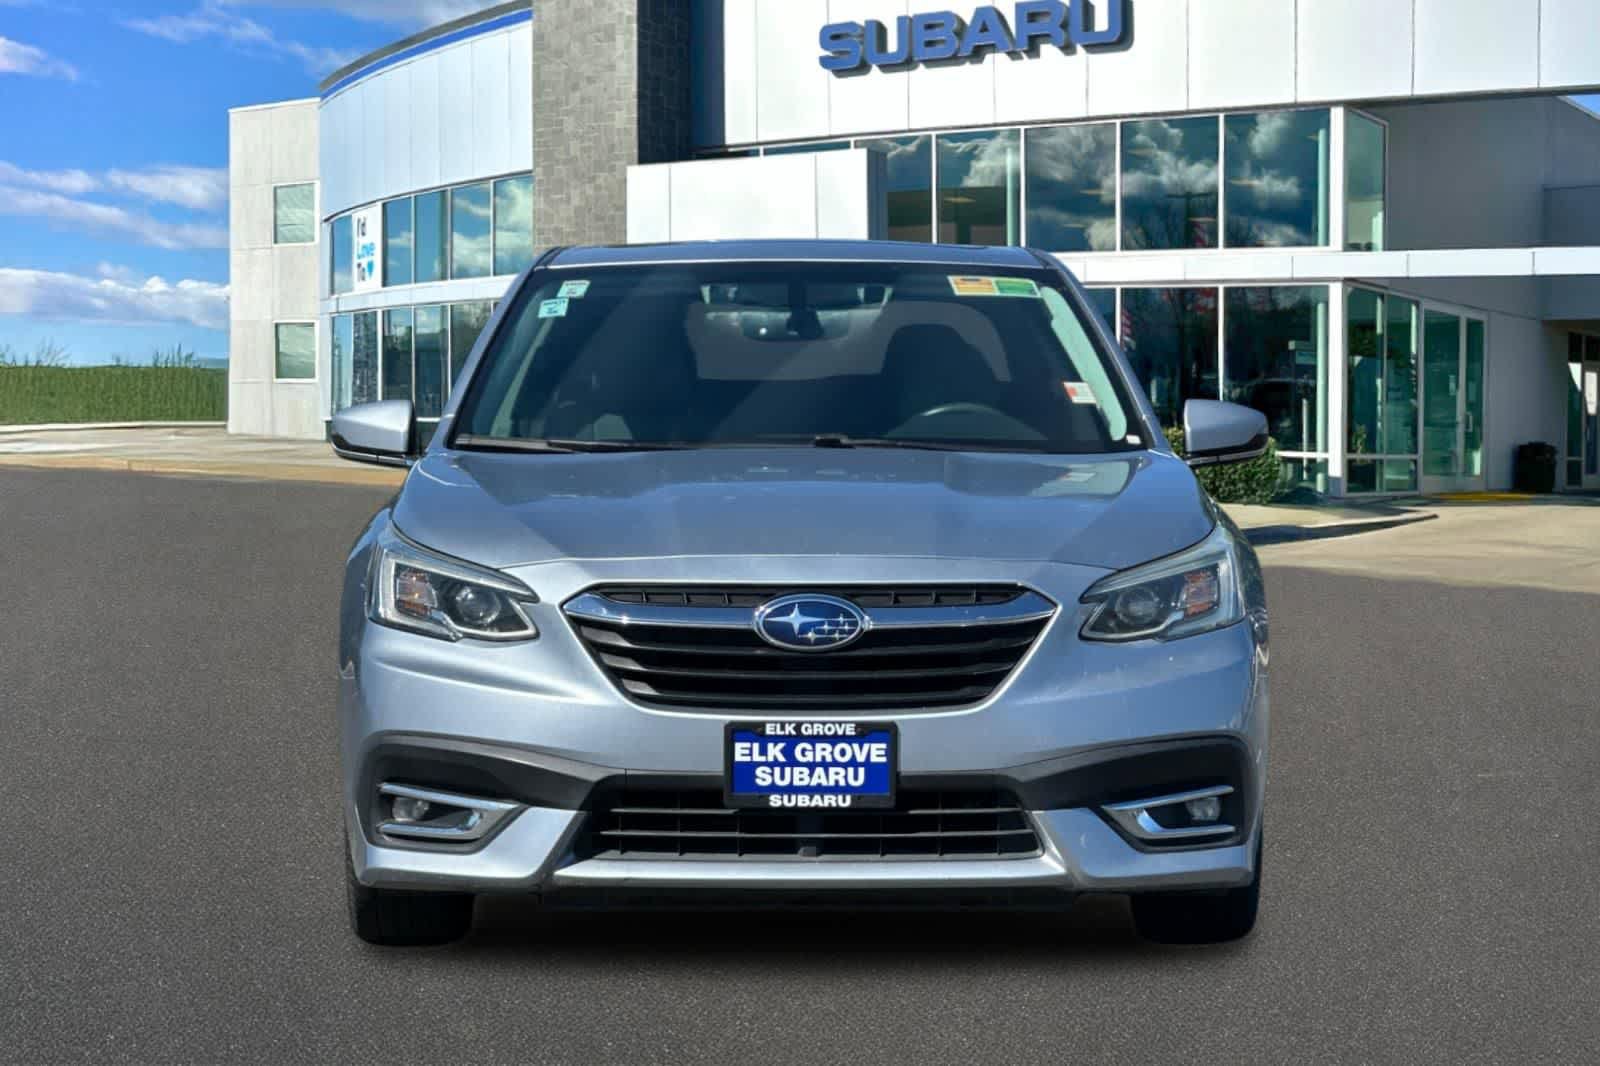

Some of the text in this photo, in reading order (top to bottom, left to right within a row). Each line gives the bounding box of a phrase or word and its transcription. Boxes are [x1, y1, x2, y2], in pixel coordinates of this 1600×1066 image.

[819, 0, 1134, 77] SUBARU
[765, 723, 856, 736] ELK GROVE
[734, 742, 887, 763] ELK GROVE
[755, 766, 865, 787] SUBARU
[769, 794, 851, 807] SUBARU
